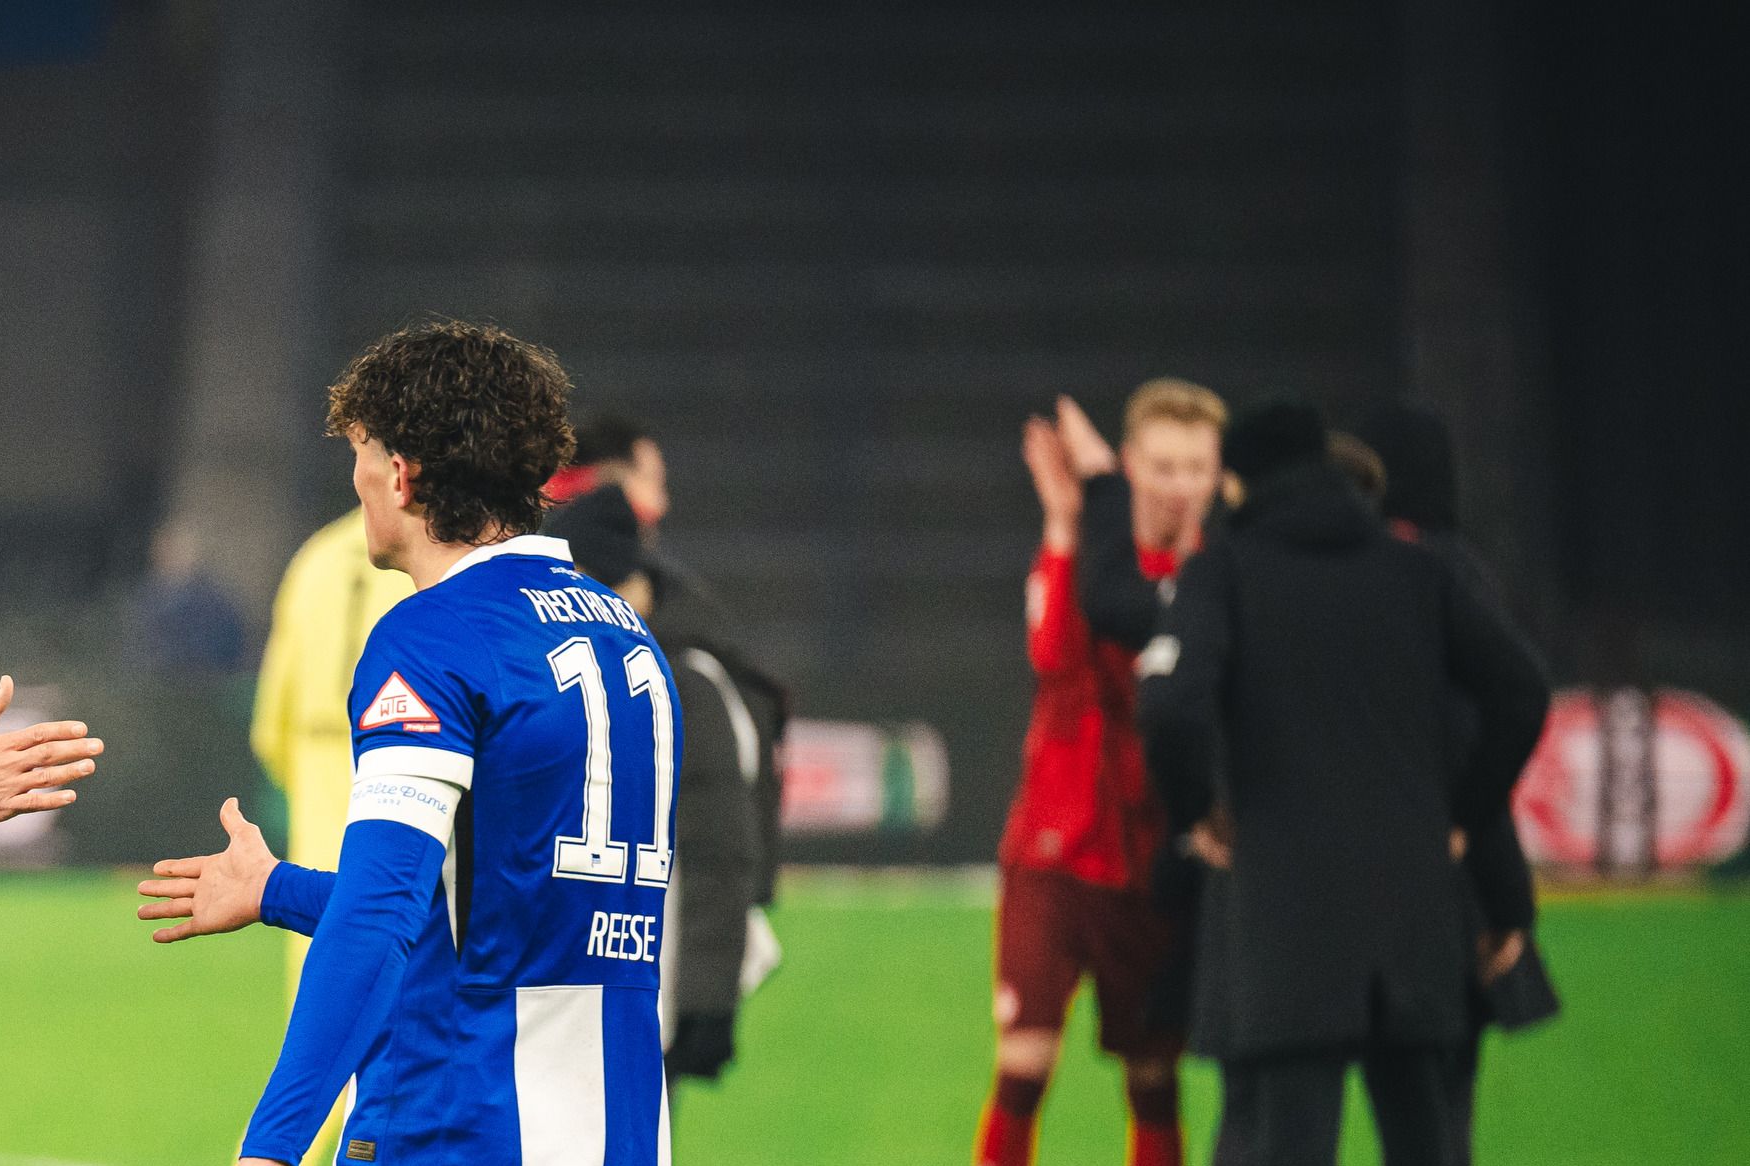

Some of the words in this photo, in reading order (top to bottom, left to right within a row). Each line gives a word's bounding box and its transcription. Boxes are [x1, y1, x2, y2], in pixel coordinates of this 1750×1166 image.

[519, 586, 621, 624] HERTHA
[380, 694, 408, 717] WTG
[546, 636, 674, 889] 11
[399, 785, 449, 815] Dame
[586, 910, 656, 963] REESE
